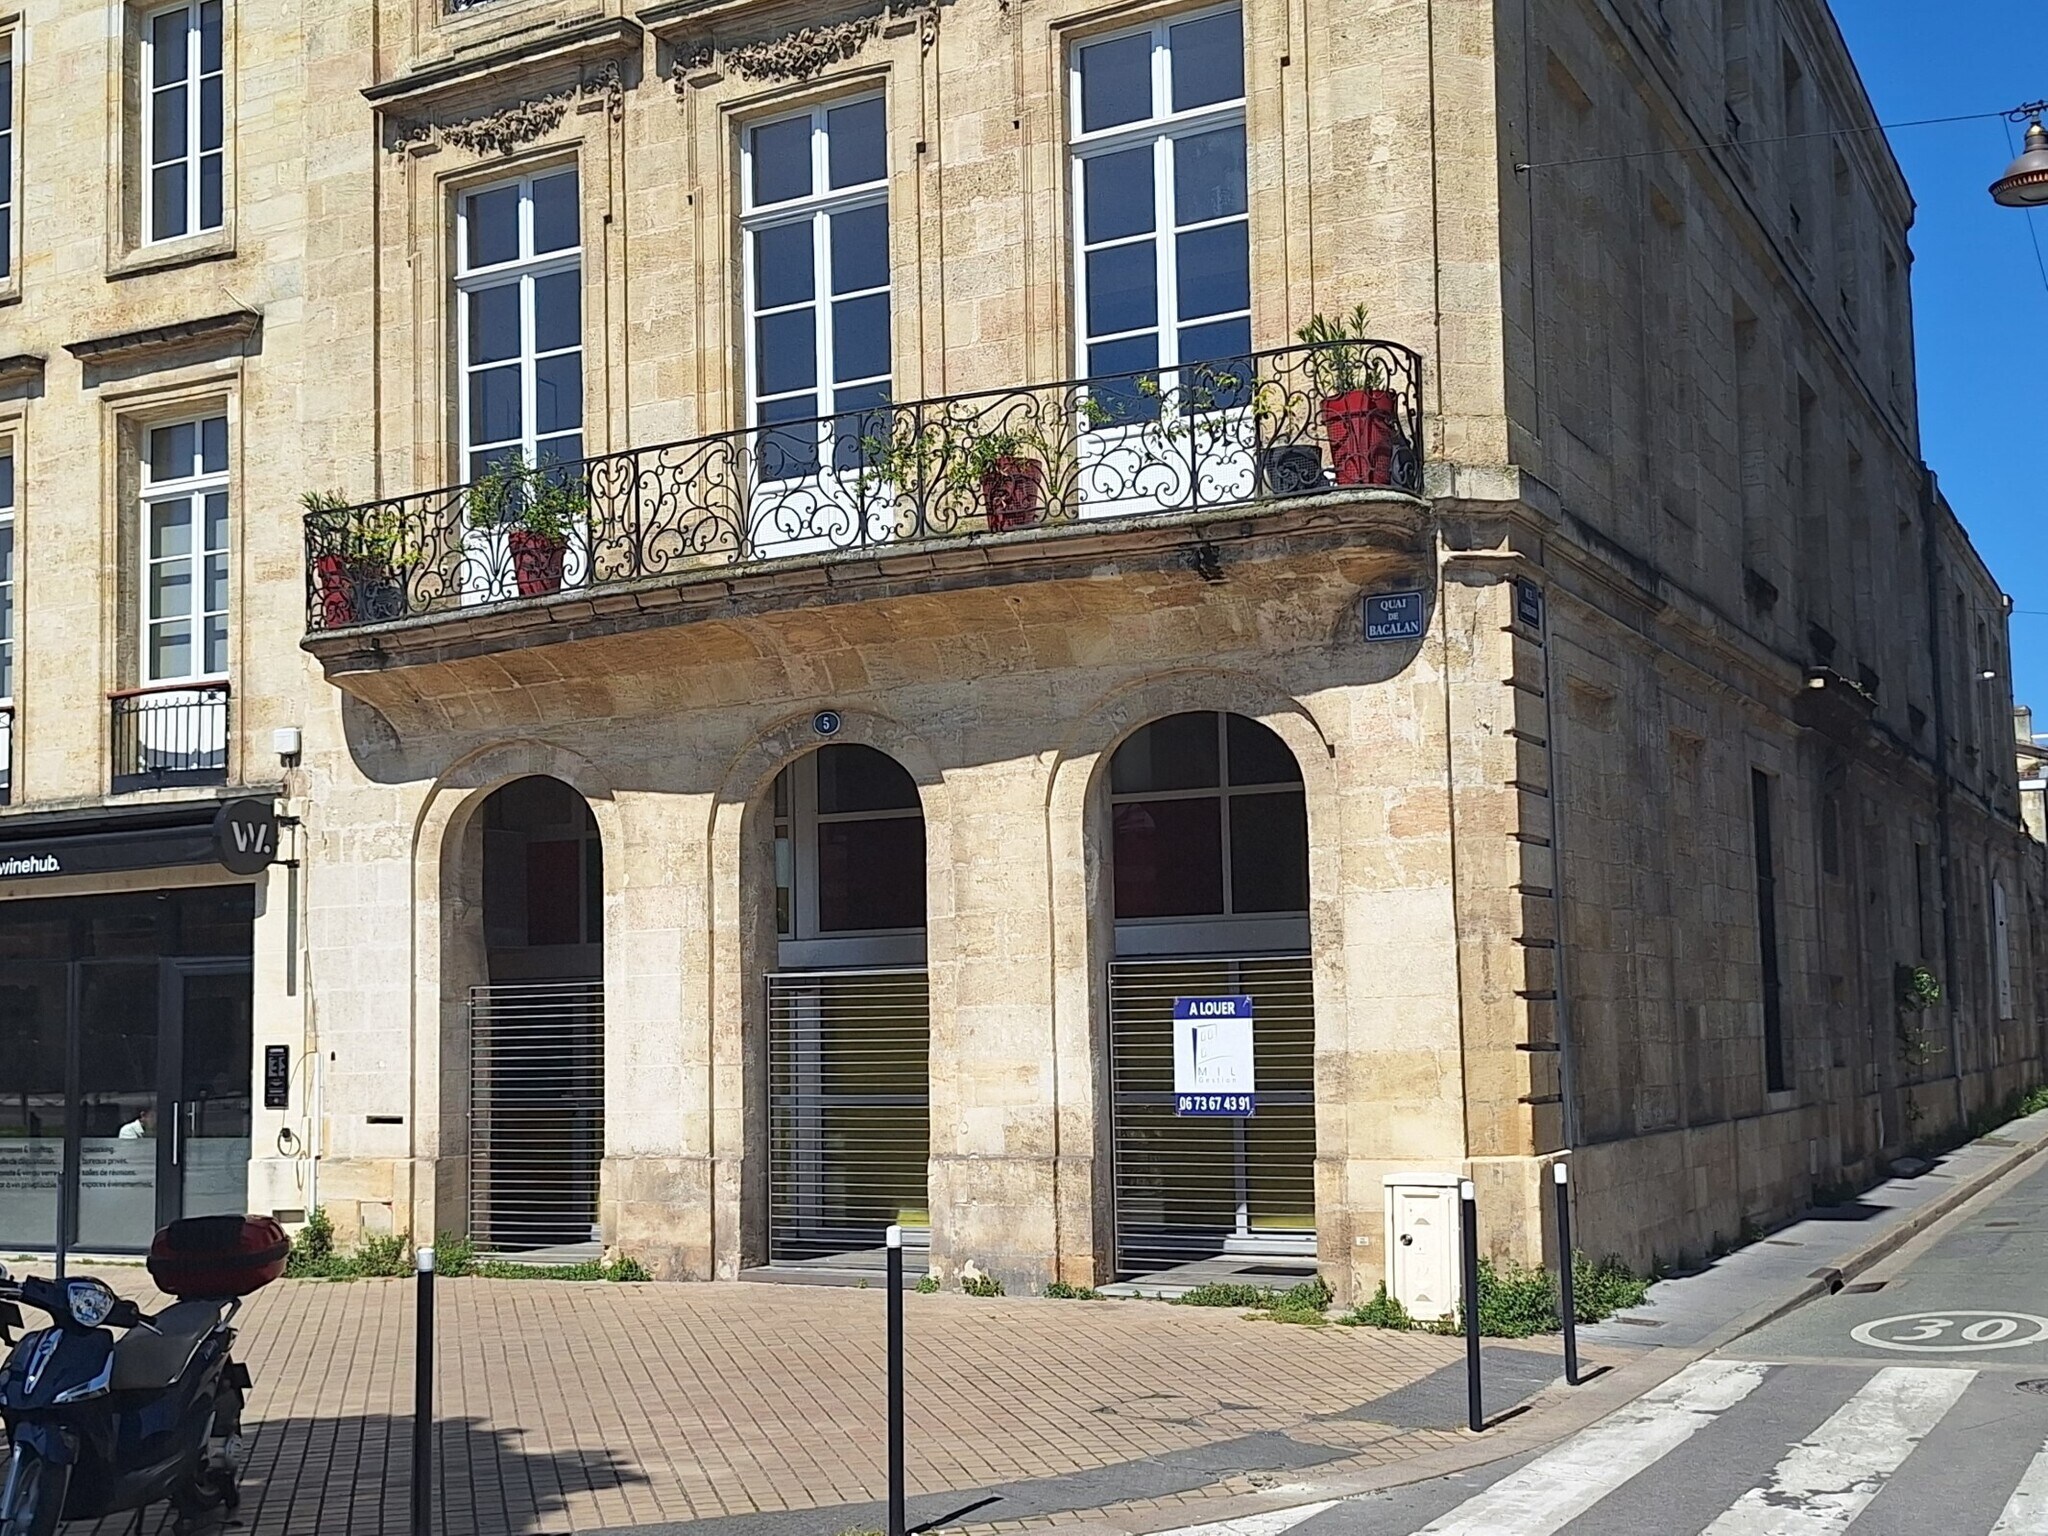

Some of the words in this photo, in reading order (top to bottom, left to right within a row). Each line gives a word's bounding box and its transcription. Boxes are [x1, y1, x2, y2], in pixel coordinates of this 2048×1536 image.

[1380, 598, 1406, 611] QUAI
[1388, 612, 1399, 621] DE
[1369, 620, 1419, 636] BACALAN
[822, 716, 830, 730] 5
[1189, 1001, 1198, 1016] A
[1200, 1001, 1235, 1016] LOUER
[1179, 1096, 1192, 1111] 06
[1194, 1096, 1207, 1111] 73
[1209, 1096, 1222, 1111] 67
[1223, 1096, 1237, 1111] 43
[1239, 1096, 1251, 1111] 91
[1891, 1318, 2018, 1342] 30
